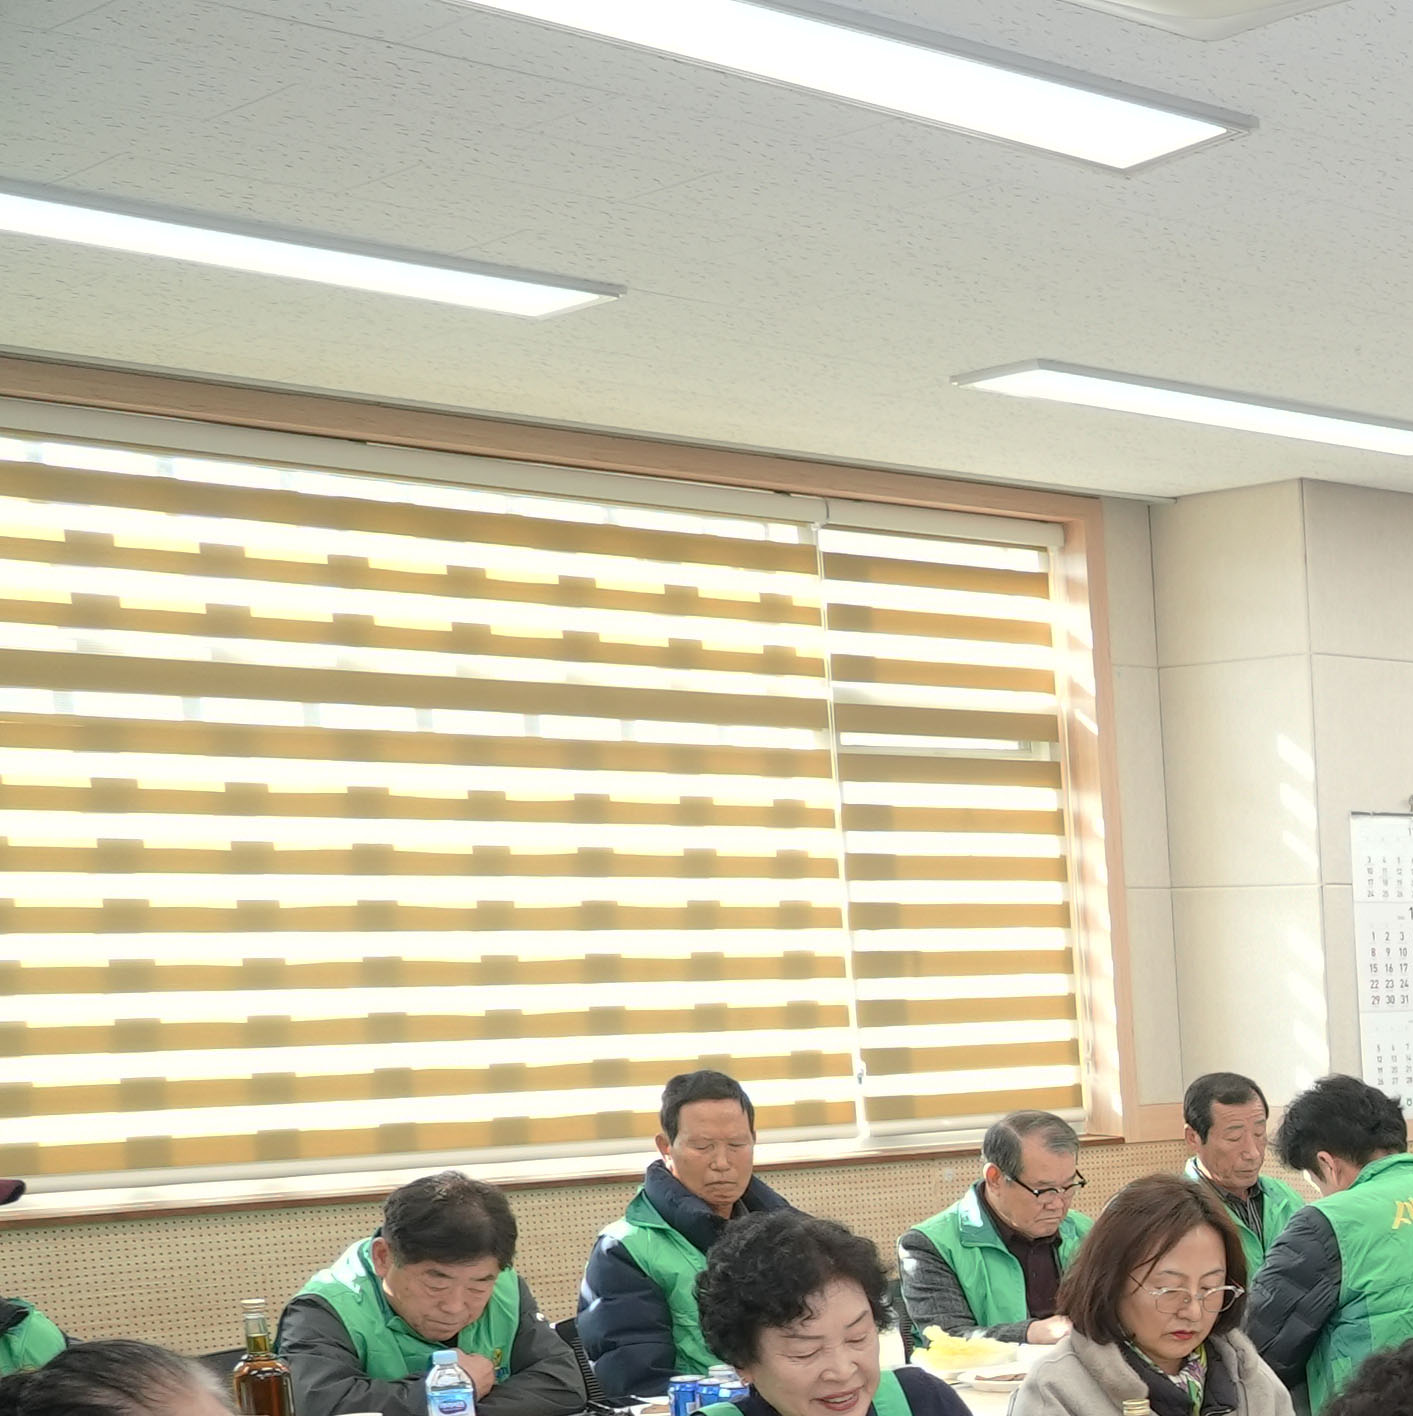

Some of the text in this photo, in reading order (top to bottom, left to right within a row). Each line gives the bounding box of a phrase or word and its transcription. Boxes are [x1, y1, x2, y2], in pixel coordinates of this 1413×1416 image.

[1371, 932, 1376, 940] 1
[1385, 932, 1390, 941] 2
[1400, 932, 1404, 941] 3
[1371, 948, 1376, 957] 8
[1386, 948, 1390, 956] 9
[1400, 948, 1407, 956] 10
[1370, 964, 1377, 973] 15
[1386, 964, 1393, 972] 16
[1400, 963, 1408, 972] 17
[1371, 980, 1379, 989] 22
[1385, 979, 1394, 988] 23
[1400, 979, 1408, 988] 24
[1372, 995, 1408, 1005] 29 30 31
